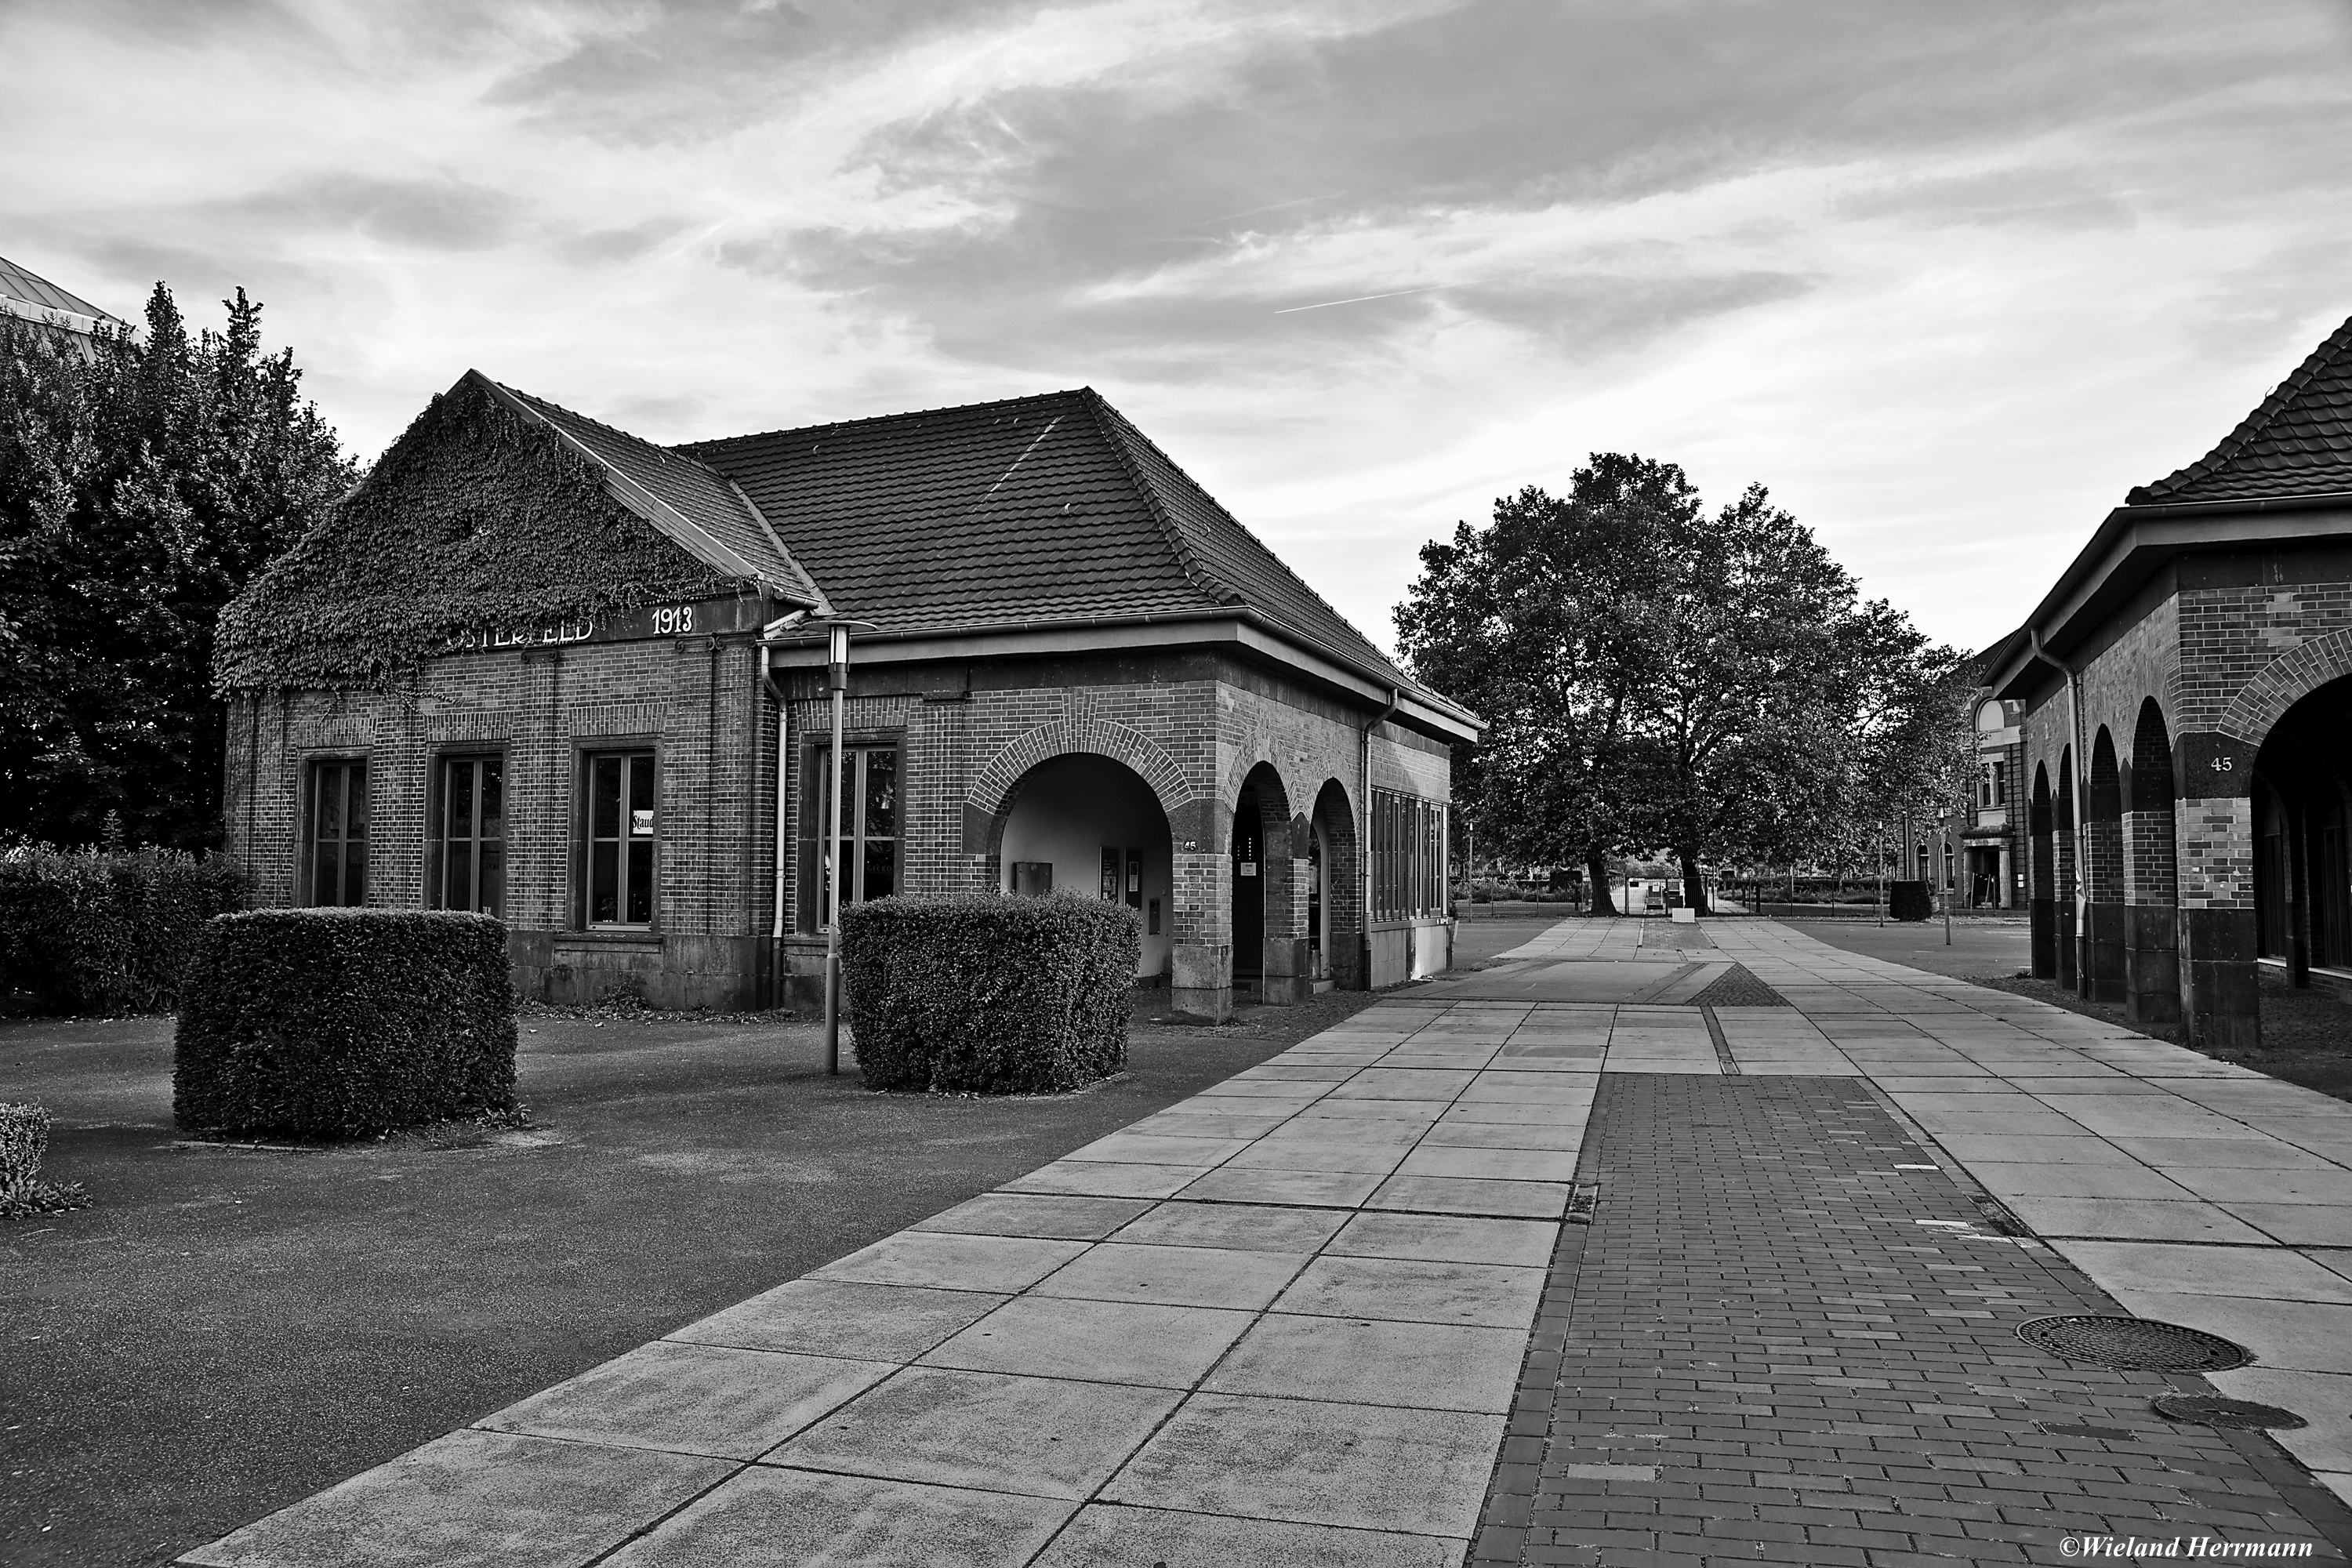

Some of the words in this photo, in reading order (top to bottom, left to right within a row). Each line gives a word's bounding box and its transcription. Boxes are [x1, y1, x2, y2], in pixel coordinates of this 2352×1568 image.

[652, 606, 693, 635] 1913
[2211, 757, 2233, 771] 45
[1185, 841, 1196, 851] 45
